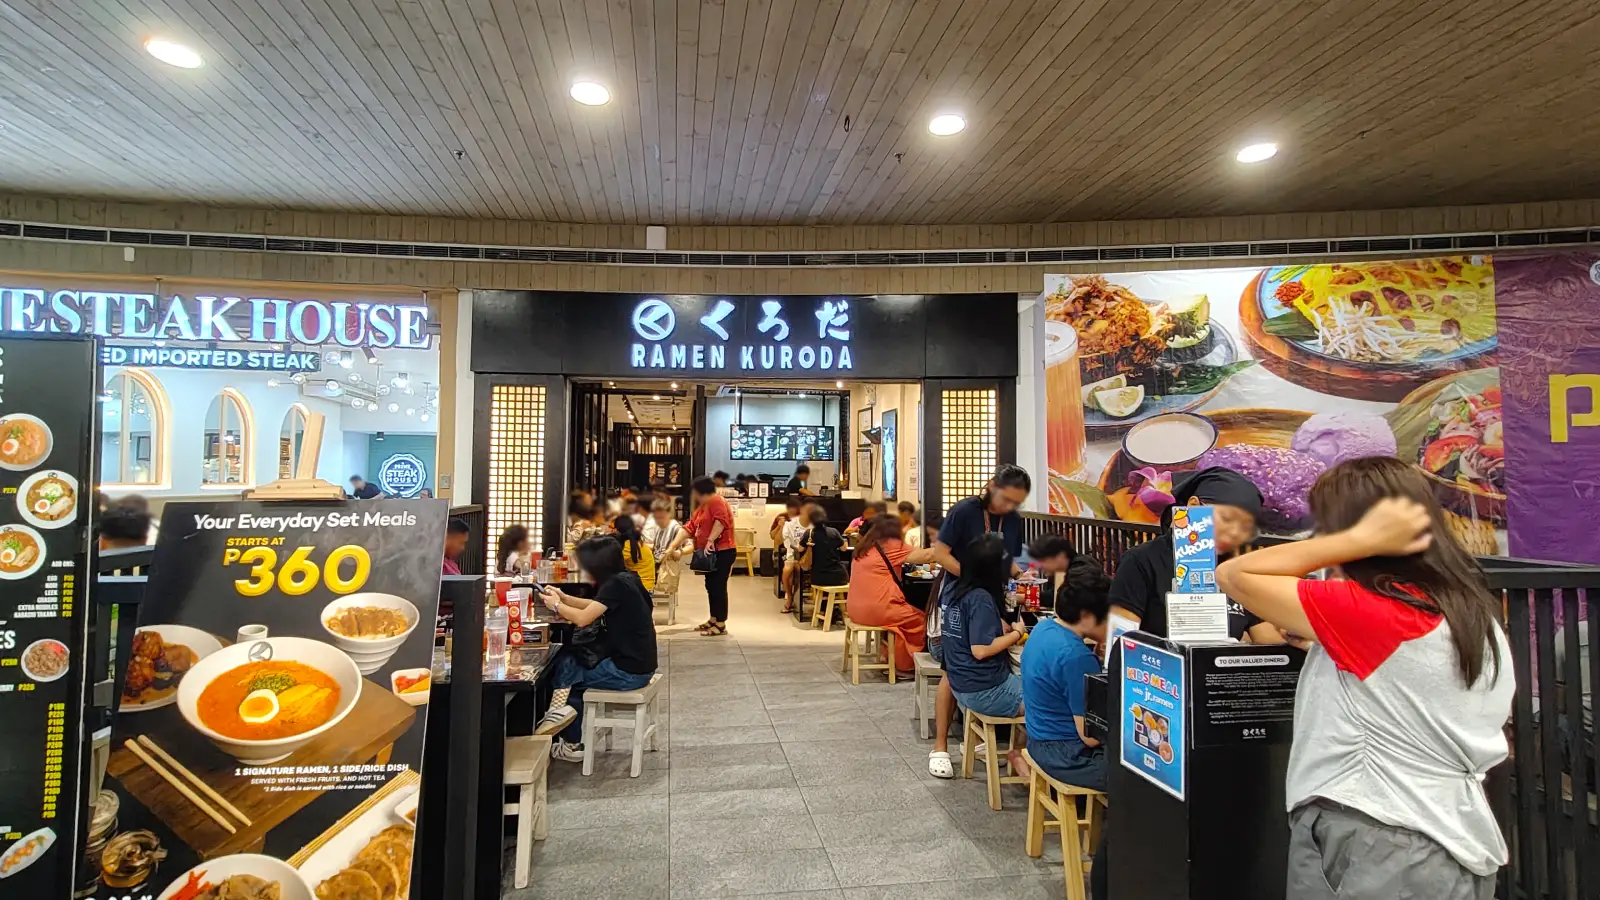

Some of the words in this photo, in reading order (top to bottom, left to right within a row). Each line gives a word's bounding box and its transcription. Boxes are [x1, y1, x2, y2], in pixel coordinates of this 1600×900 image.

[250, 297, 431, 349] HOUSE
[700, 299, 850, 342] くろだ
[133, 348, 243, 367] IMPORTED
[248, 352, 315, 370] STEAK
[631, 343, 725, 369] RAMEN
[741, 345, 853, 370] KURODA
[386, 469, 418, 477] STEAK
[193, 514, 235, 530] Your
[238, 512, 325, 532] Everyday
[326, 512, 360, 527] Set
[363, 510, 418, 527] Meals
[1174, 515, 1213, 540] RAMEN
[226, 537, 269, 546] STARTS
[270, 536, 286, 546] AT
[1126, 666, 1150, 685] KIDS
[1150, 672, 1180, 701] MEAL
[1132, 686, 1144, 696] with
[234, 768, 241, 776] 1
[242, 766, 295, 776] SIGNATURE
[296, 765, 331, 775] RAMEN,
[332, 765, 338, 774] 1
[340, 764, 386, 774] SIDE/RICE
[387, 763, 409, 772] DISH
